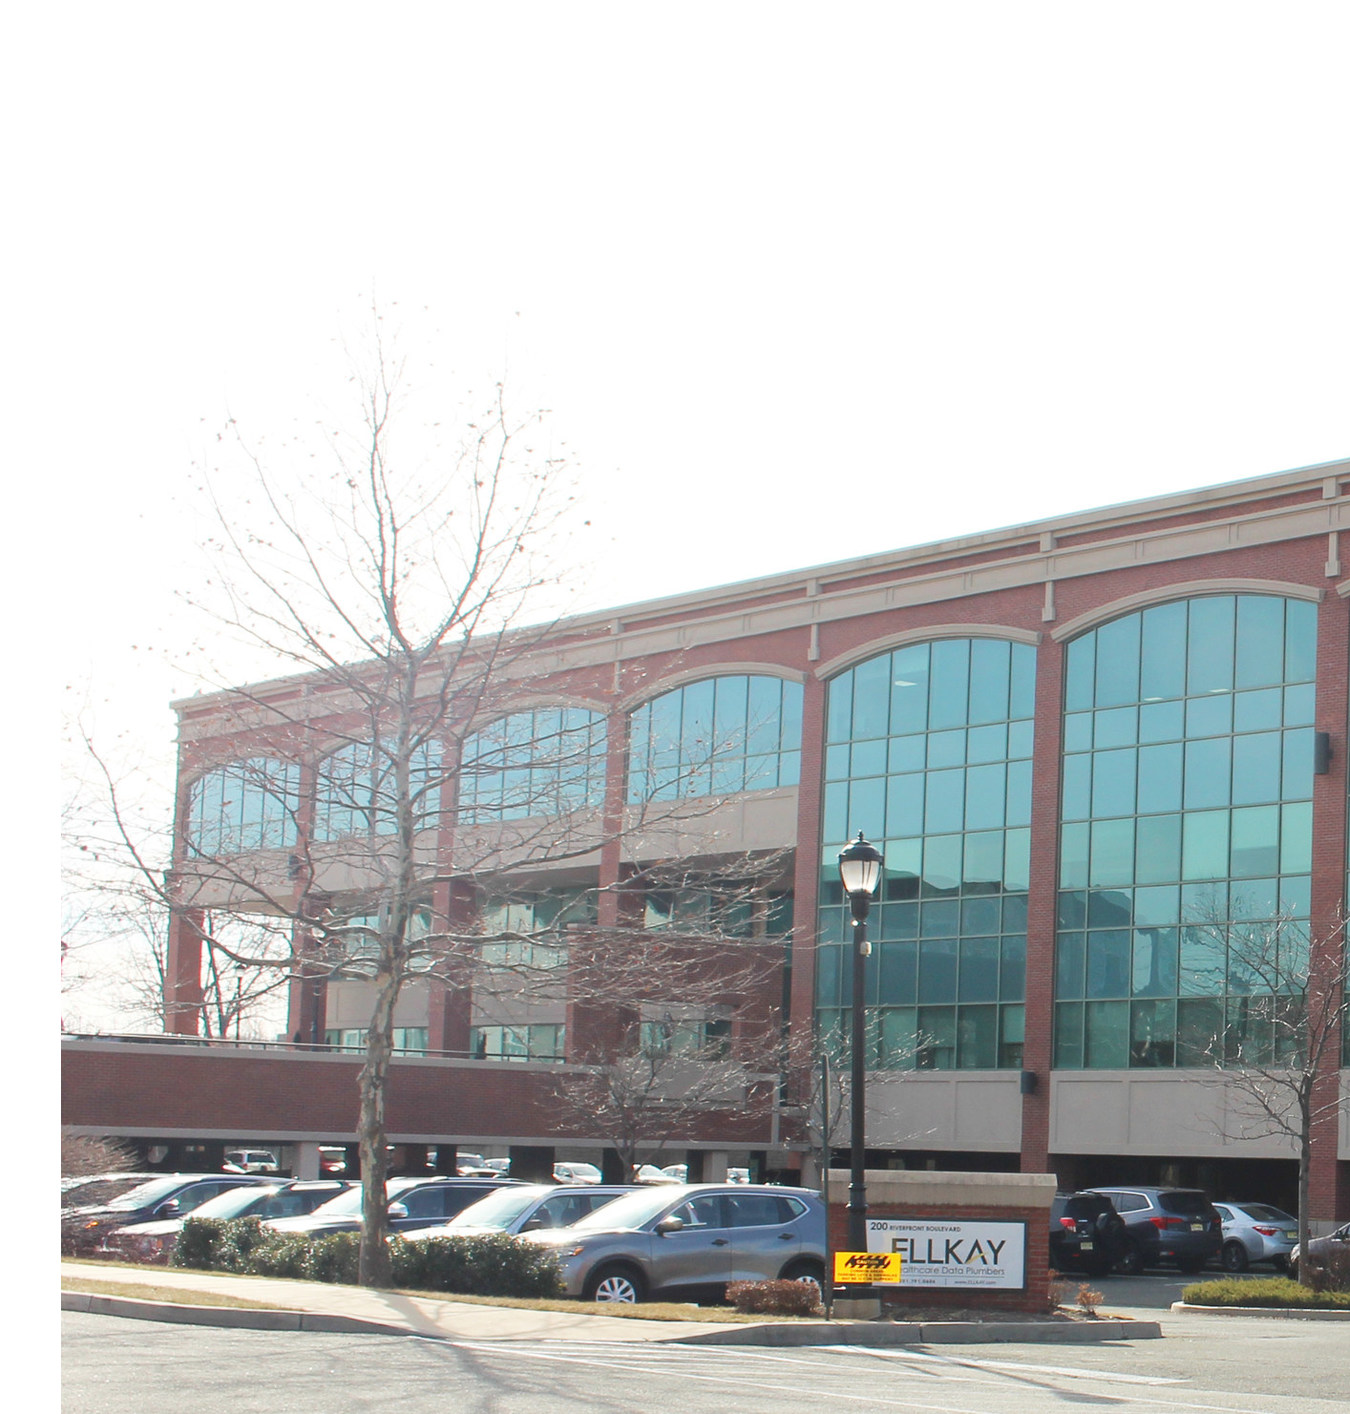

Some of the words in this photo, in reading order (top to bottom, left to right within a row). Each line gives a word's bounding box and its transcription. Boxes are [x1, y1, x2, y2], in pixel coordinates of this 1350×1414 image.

[870, 1222, 888, 1230] 200
[892, 1238, 1006, 1265] ELLKAY
[941, 1266, 964, 1275] Data
[966, 1267, 1005, 1276] Plumbers
